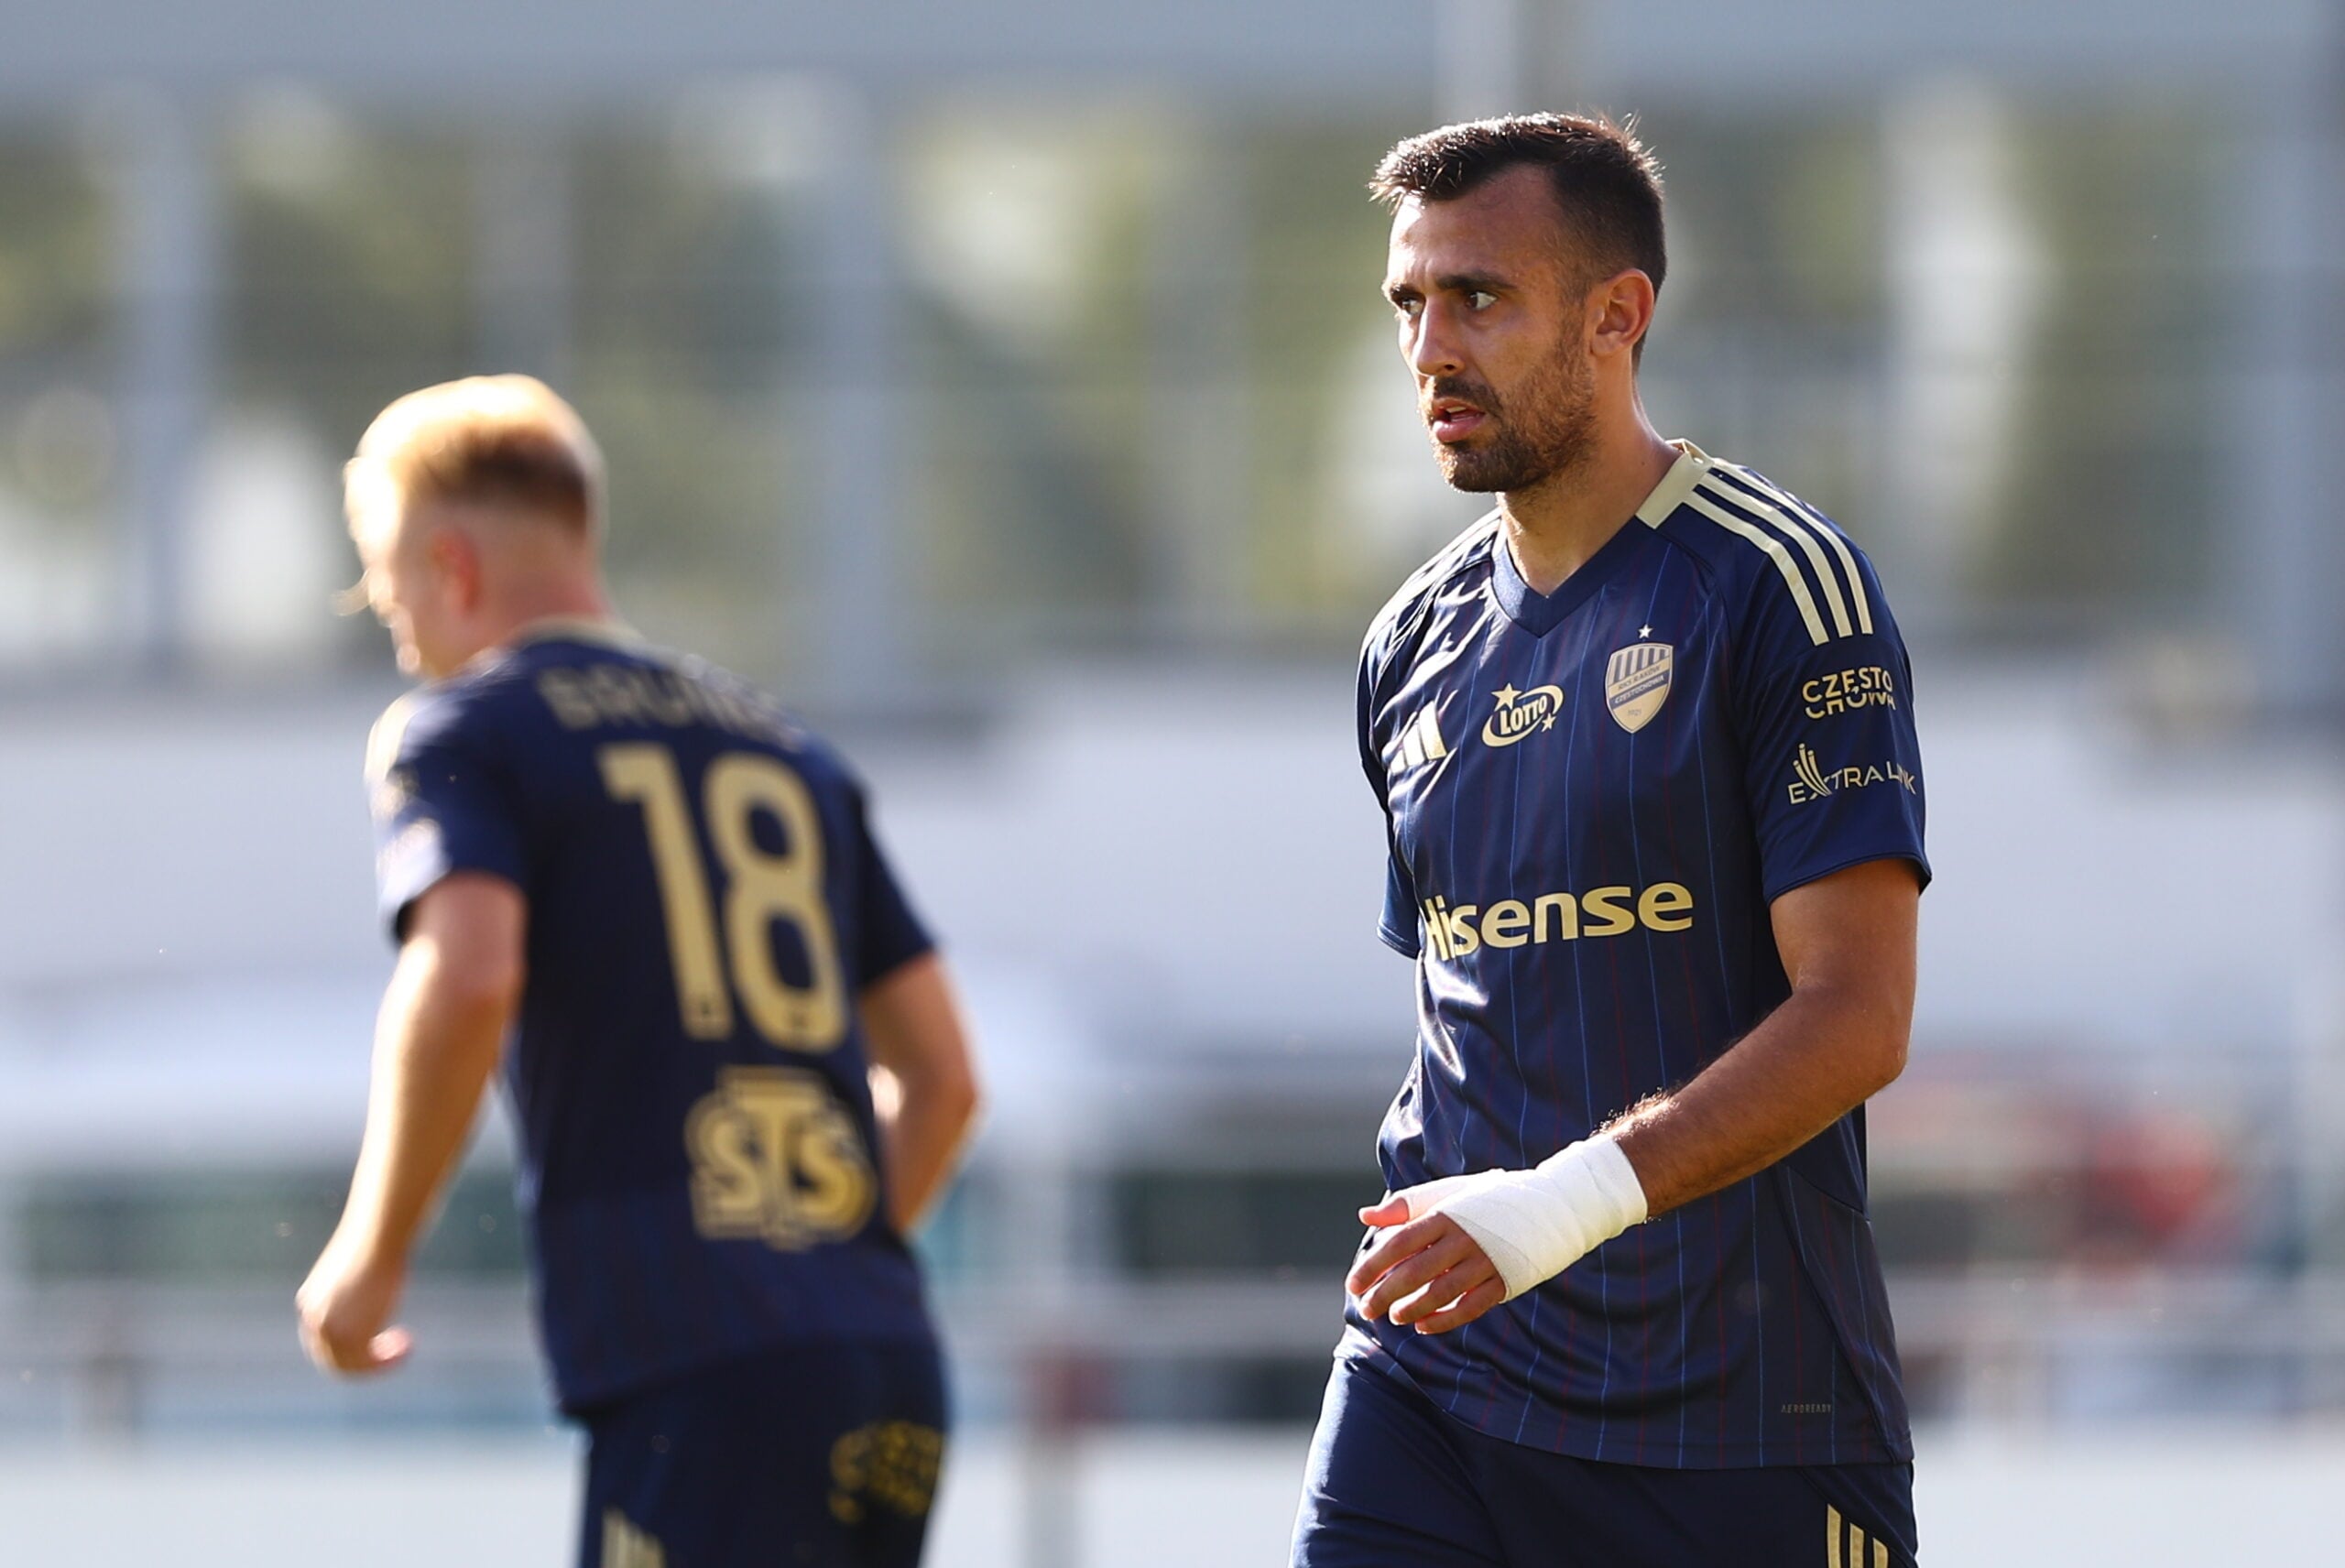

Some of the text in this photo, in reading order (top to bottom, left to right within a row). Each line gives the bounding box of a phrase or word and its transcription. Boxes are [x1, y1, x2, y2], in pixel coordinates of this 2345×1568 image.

[1500, 694, 1548, 735] LOTTO
[600, 743, 846, 1051] 18
[1423, 881, 1694, 962] Hisense
[687, 1068, 875, 1247] STS
